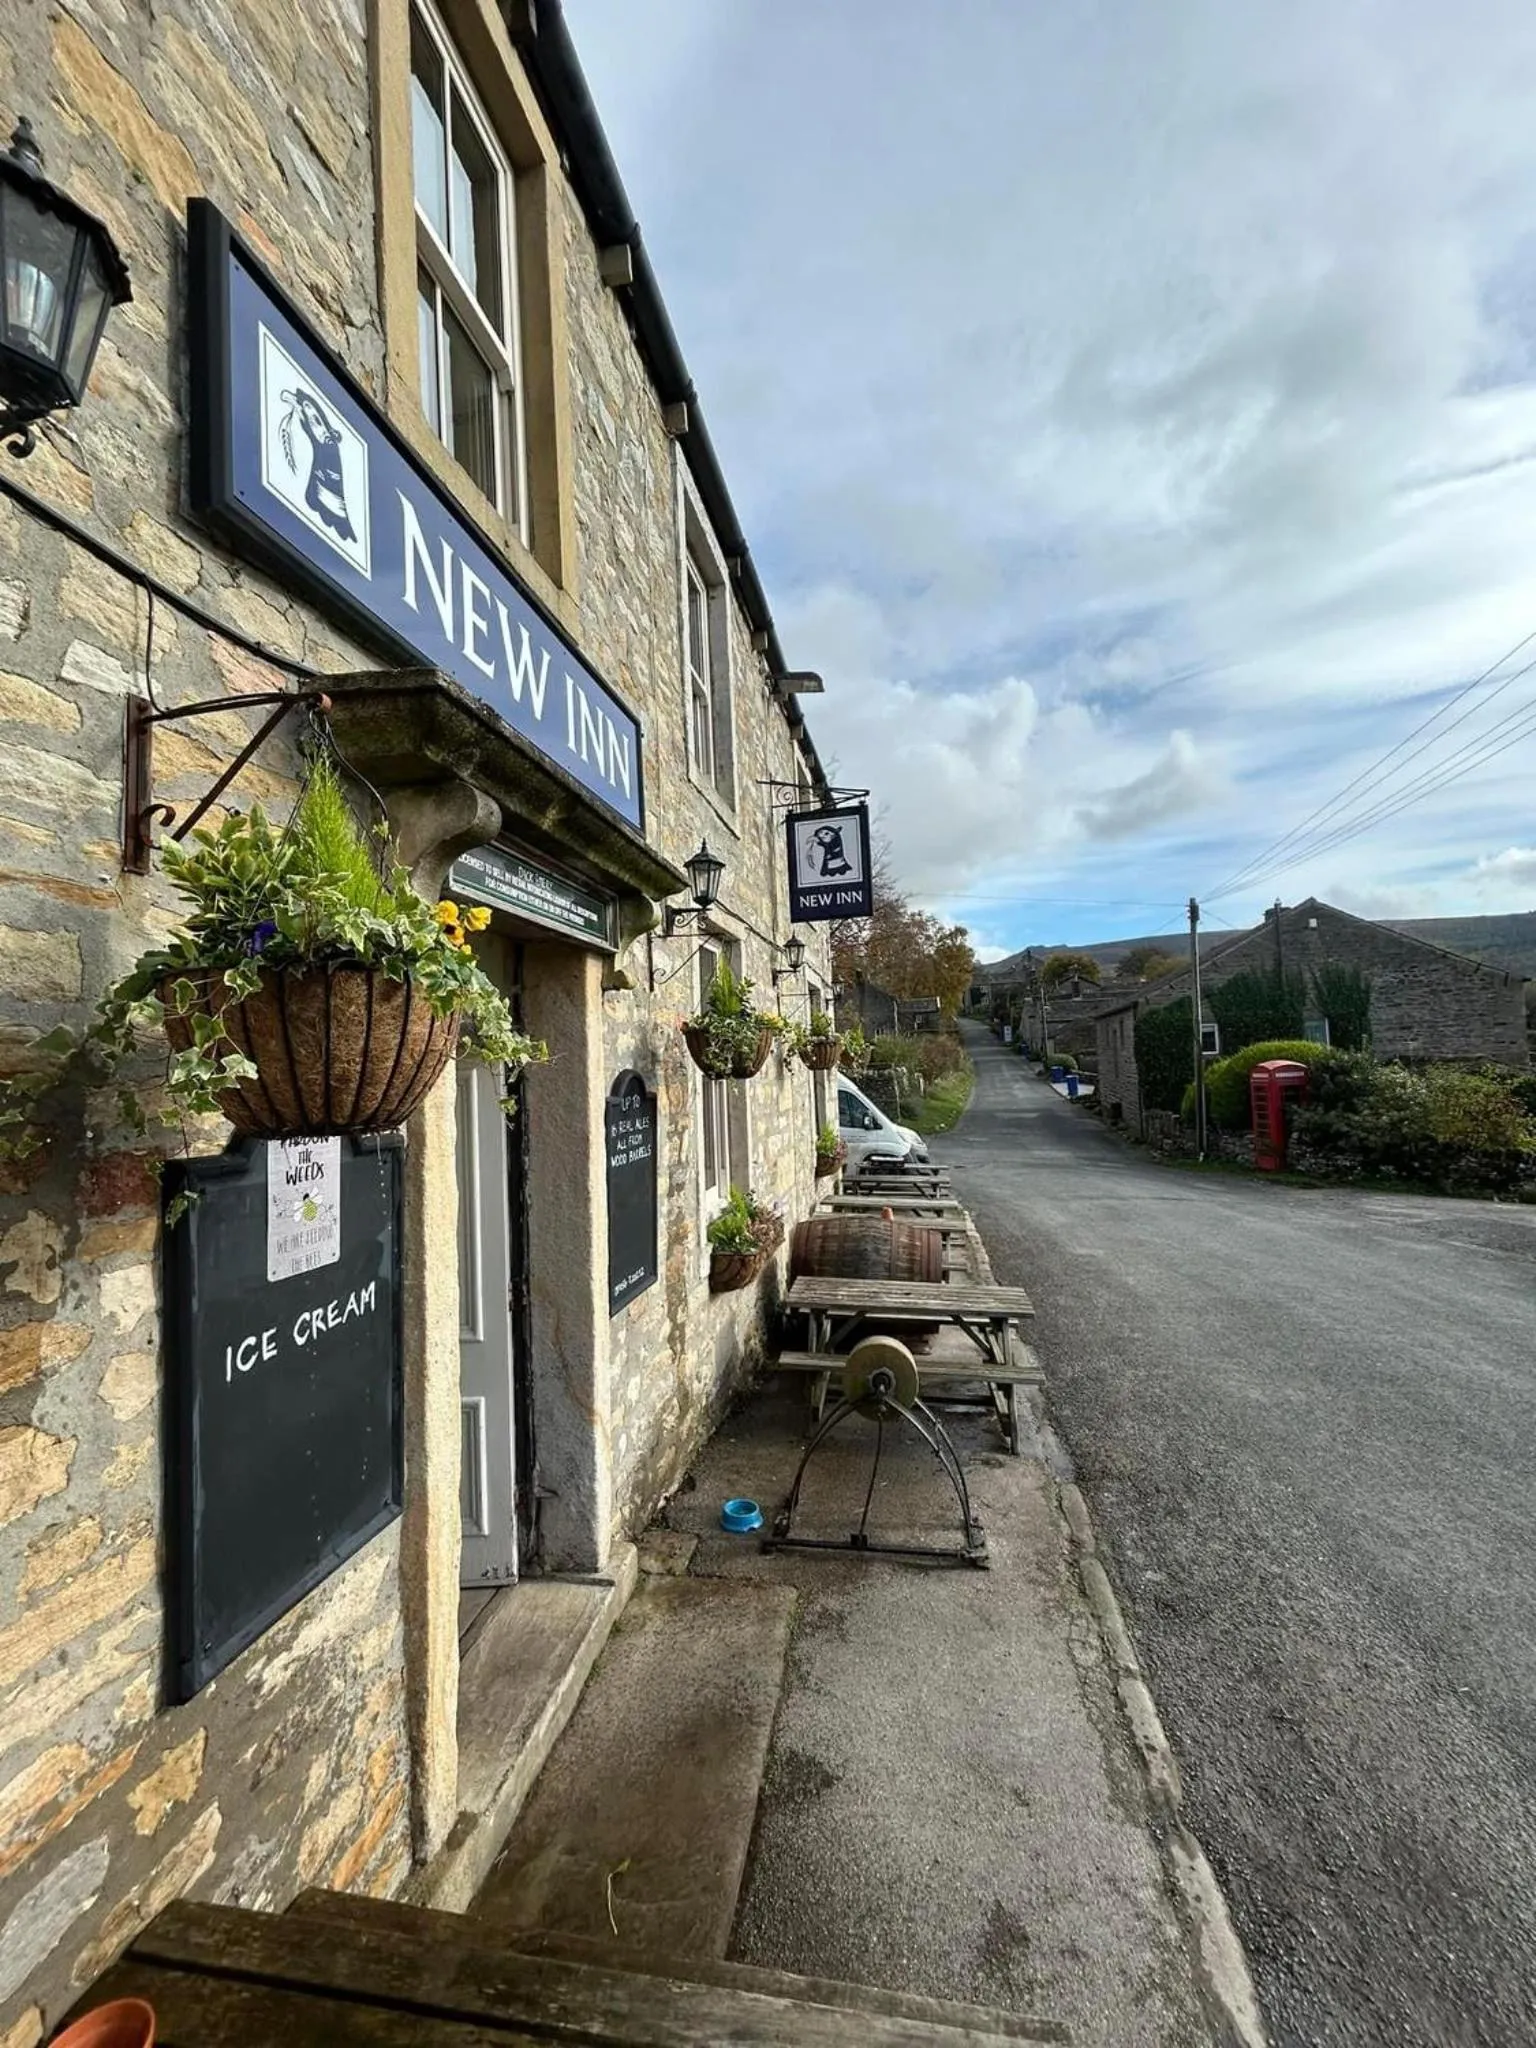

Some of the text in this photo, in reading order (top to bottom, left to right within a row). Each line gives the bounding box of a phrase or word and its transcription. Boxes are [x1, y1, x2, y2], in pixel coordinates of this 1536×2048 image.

[396, 488, 631, 799] NEW INN
[799, 890, 863, 908] NEW INN
[634, 1115, 650, 1130] ALES
[298, 1148, 313, 1165] THE
[610, 1153, 628, 1168] WOOD
[285, 1161, 325, 1186] WEEDS
[225, 1280, 376, 1383] ICE CREAM
